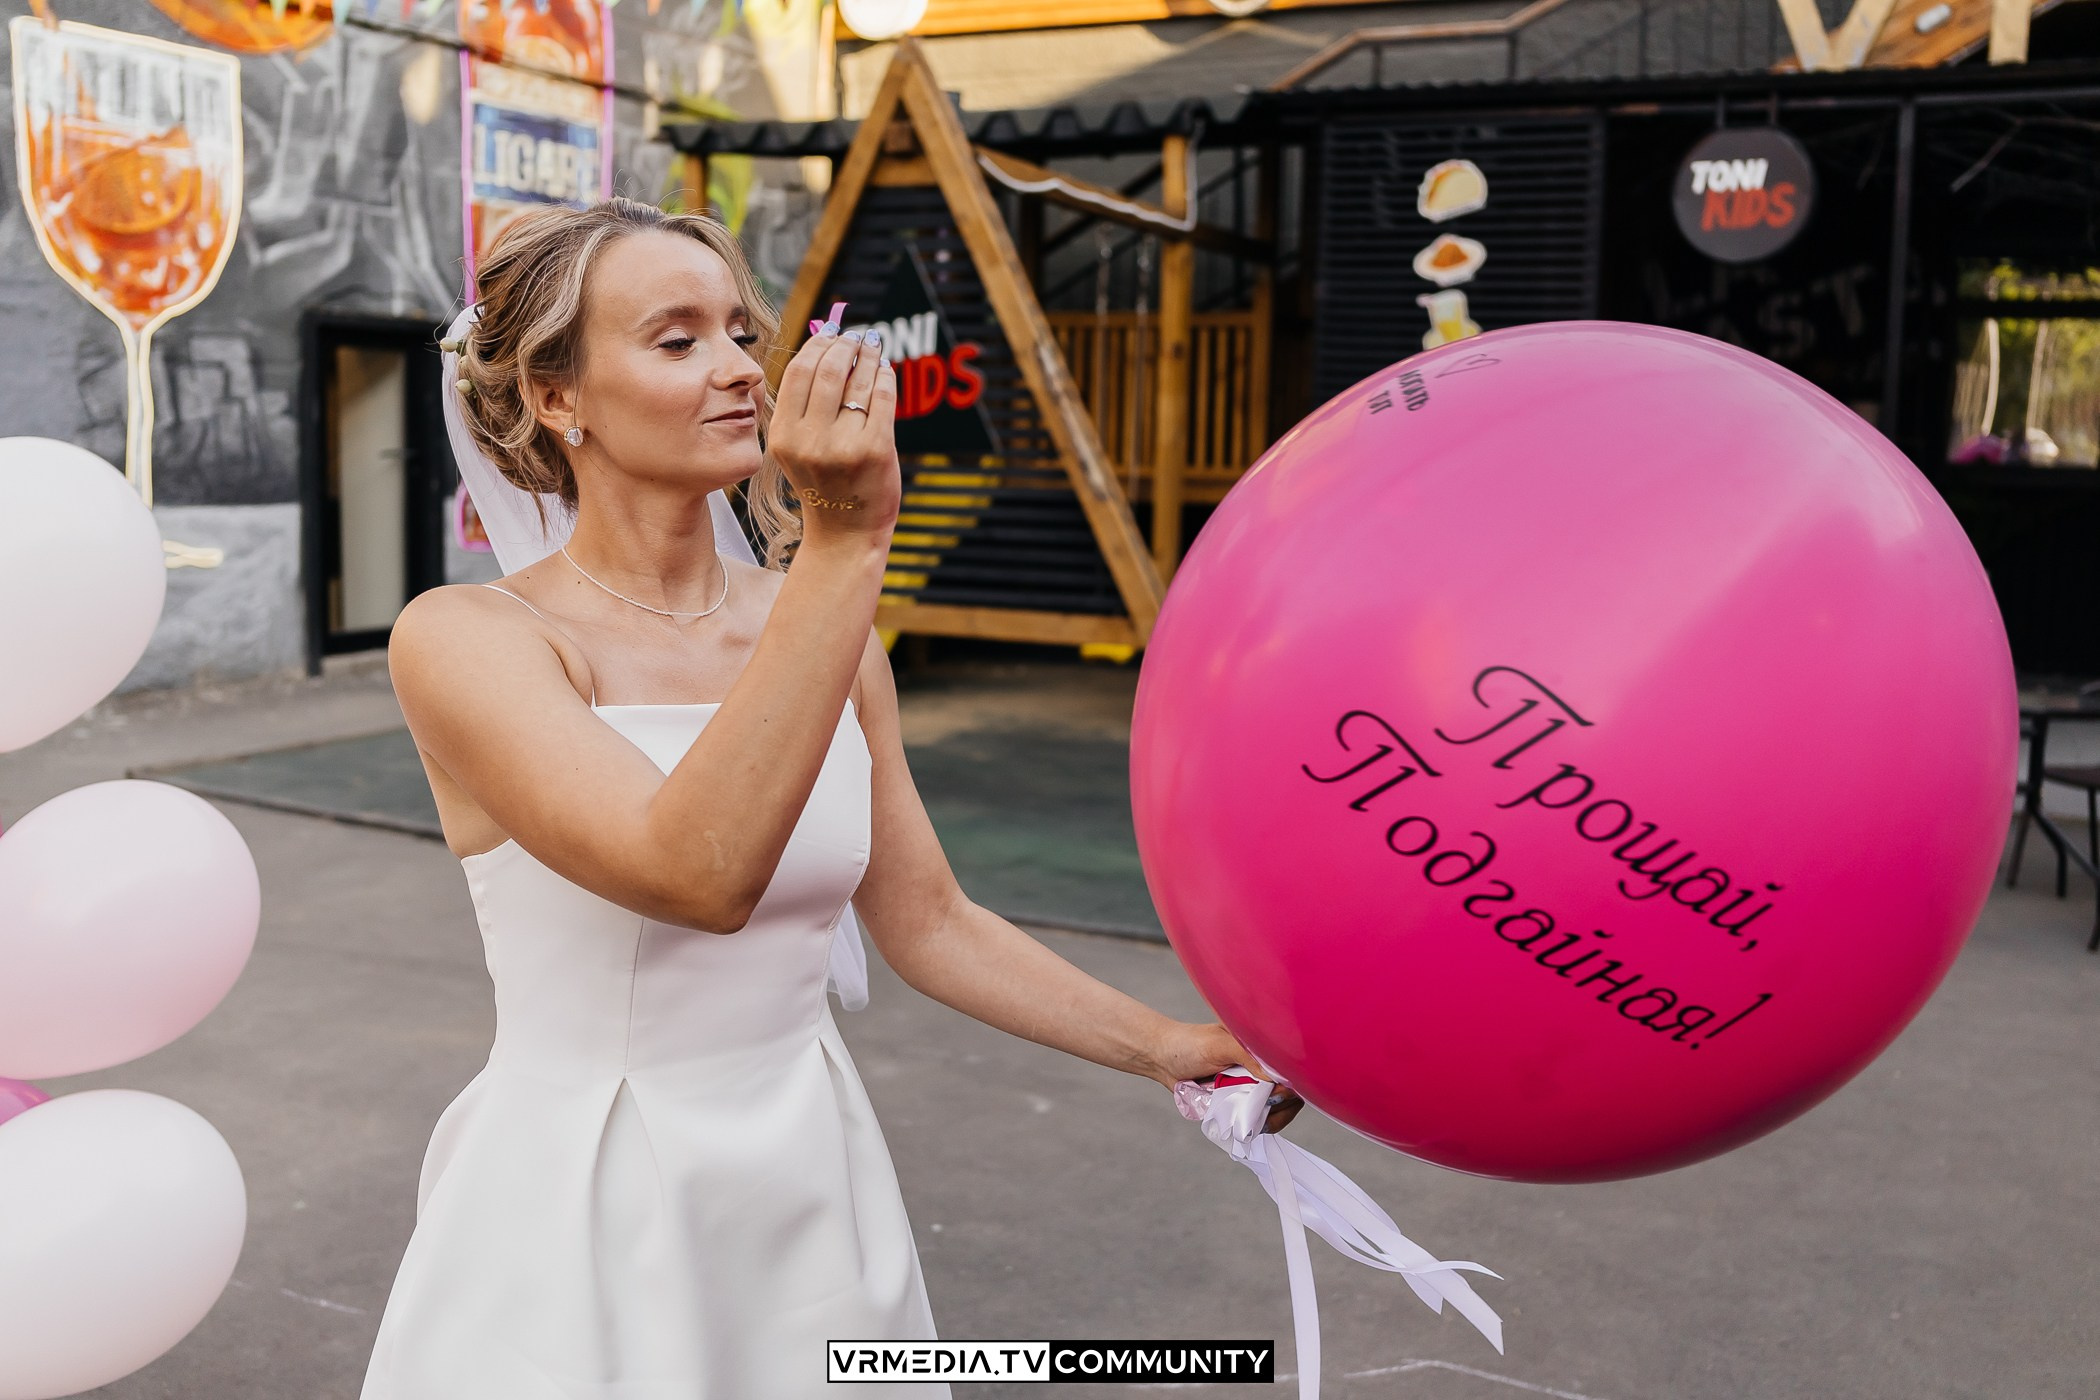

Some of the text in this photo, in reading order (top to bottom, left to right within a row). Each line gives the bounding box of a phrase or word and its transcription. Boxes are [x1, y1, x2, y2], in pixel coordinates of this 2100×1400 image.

[1690, 157, 1769, 194] TONI
[1702, 181, 1796, 232] KIDS
[843, 312, 938, 366] ONI
[892, 342, 986, 420] IDS
[1434, 665, 1785, 952] Прощай,
[1302, 709, 1774, 1050] Подгайная!
